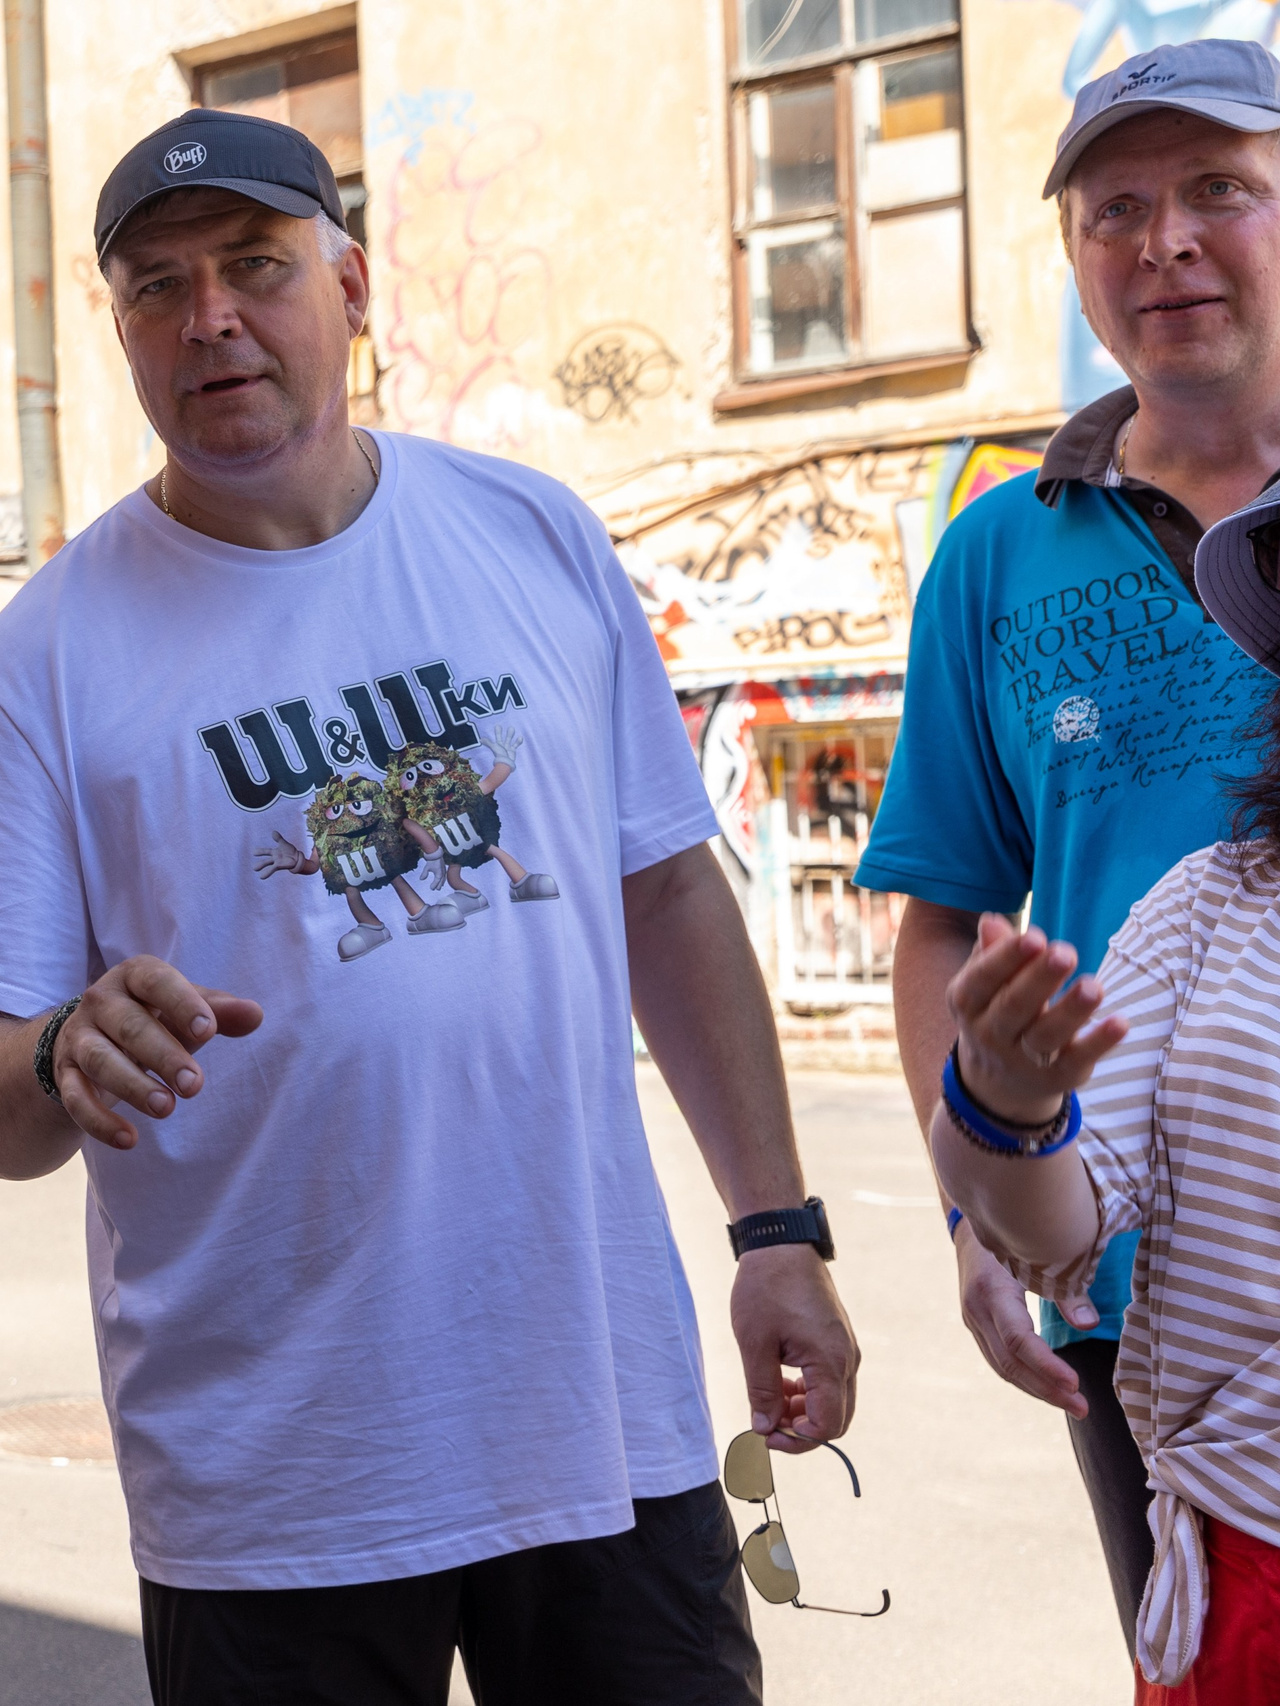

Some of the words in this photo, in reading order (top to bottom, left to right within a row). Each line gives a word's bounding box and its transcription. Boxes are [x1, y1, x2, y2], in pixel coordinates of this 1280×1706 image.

[990, 563, 1171, 646] OUTDOOR
[1000, 597, 1178, 675] WORLD
[1007, 626, 1188, 712] TRAVEL
